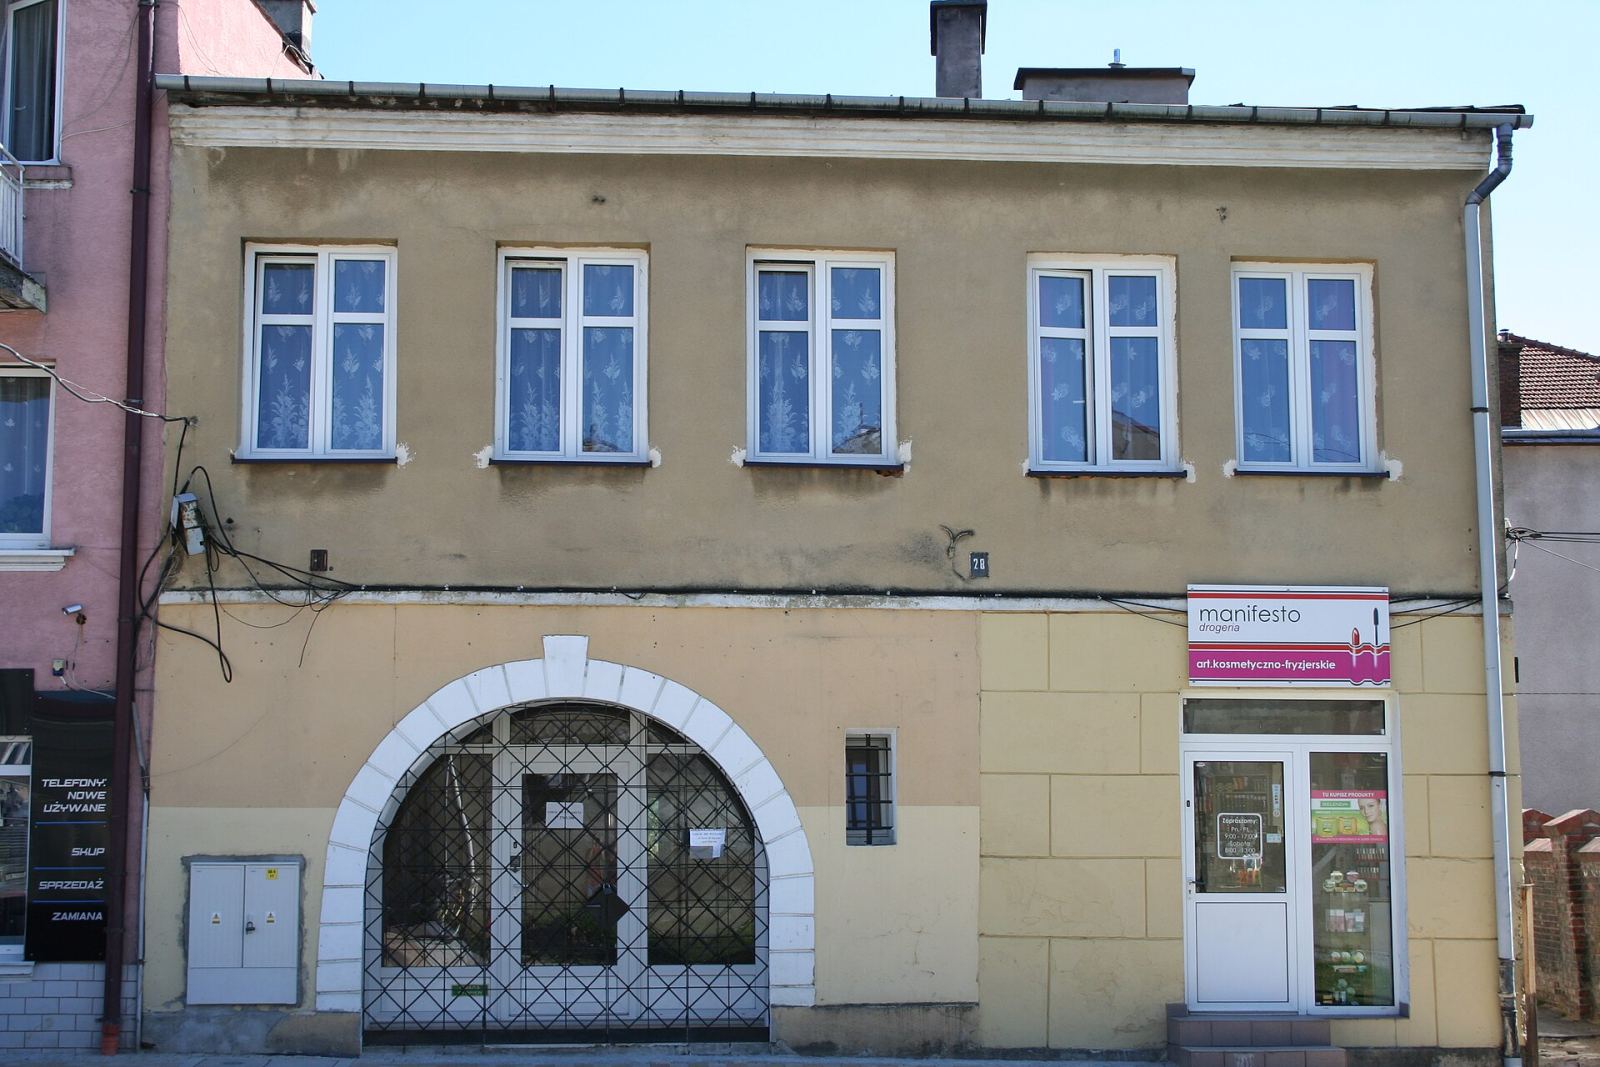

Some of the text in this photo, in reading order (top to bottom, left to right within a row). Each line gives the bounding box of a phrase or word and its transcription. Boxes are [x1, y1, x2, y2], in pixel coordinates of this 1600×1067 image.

[973, 558, 985, 570] 28
[1199, 605, 1301, 623] manifesto
[1199, 623, 1240, 634] drogeria
[67, 791, 107, 800] NOWE
[43, 801, 107, 813] UŻYWANE
[71, 847, 106, 856] SKUP
[38, 878, 104, 890] SPRZEDAŻ
[51, 912, 103, 921] ZAMIANA
